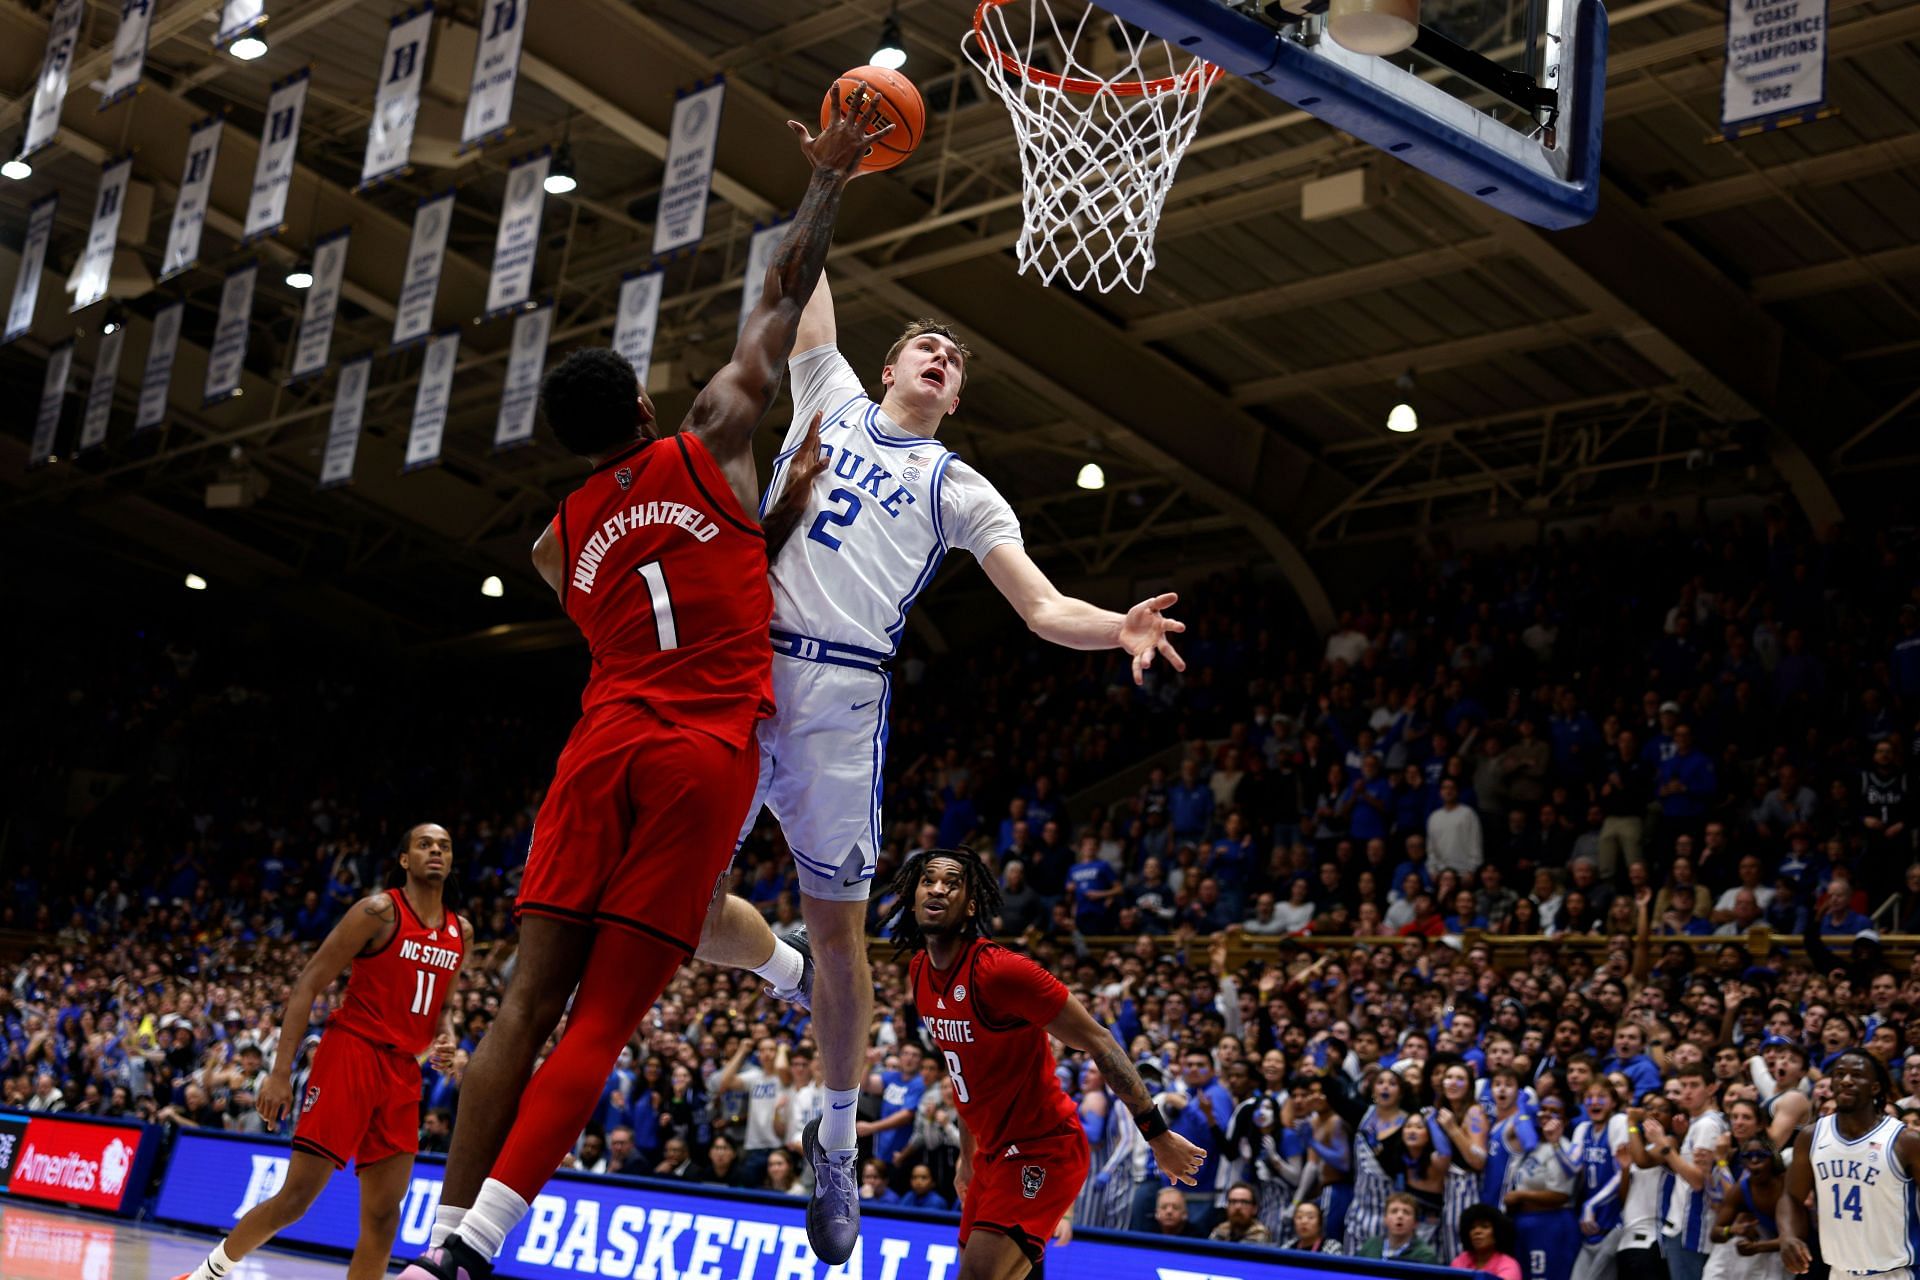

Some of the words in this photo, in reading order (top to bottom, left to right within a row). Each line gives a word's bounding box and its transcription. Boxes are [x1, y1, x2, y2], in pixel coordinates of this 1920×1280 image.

[1732, 16, 1822, 50] CONFERENCE
[1753, 4, 1798, 26] COAST
[1734, 37, 1818, 70] CHAMPIONS
[1753, 83, 1792, 105] 2002
[818, 442, 916, 518] DUKE
[808, 488, 863, 552] 2
[572, 501, 720, 594] HUNTLEY-HATFIELD
[637, 561, 678, 651] 1
[400, 938, 421, 960] NC
[421, 945, 460, 971] STATE
[411, 969, 436, 1016] 11
[922, 1015, 936, 1039] NC
[936, 1018, 975, 1043] STATE
[943, 1050, 970, 1104] 8
[14, 1143, 99, 1192] Ameritas
[1817, 1159, 1880, 1186] DUKE
[1831, 1183, 1863, 1222] 14
